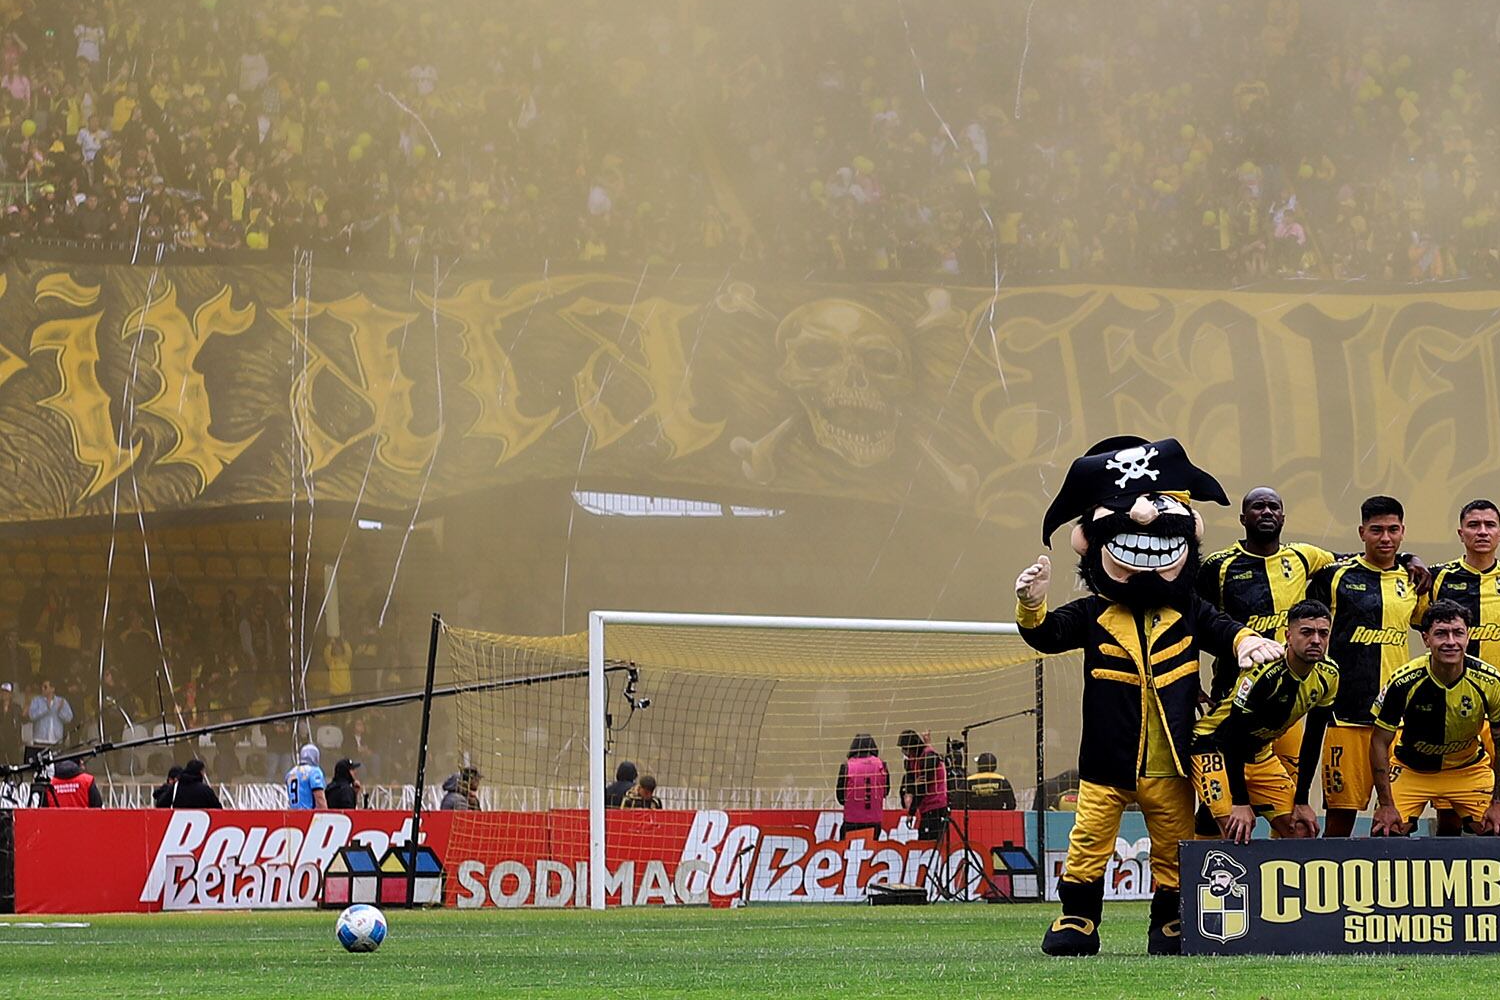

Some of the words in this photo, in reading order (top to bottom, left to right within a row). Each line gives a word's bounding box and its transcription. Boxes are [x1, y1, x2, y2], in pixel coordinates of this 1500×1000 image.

[1246, 610, 1289, 634] RojaB
[1201, 754, 1223, 773] 28
[1330, 746, 1344, 768] 17
[291, 778, 299, 805] 9
[164, 854, 320, 906] Betano
[750, 834, 985, 902] Betano
[457, 860, 710, 908] SODIMAC
[1343, 913, 1454, 943] SOMOS
[1464, 912, 1499, 943] LA
